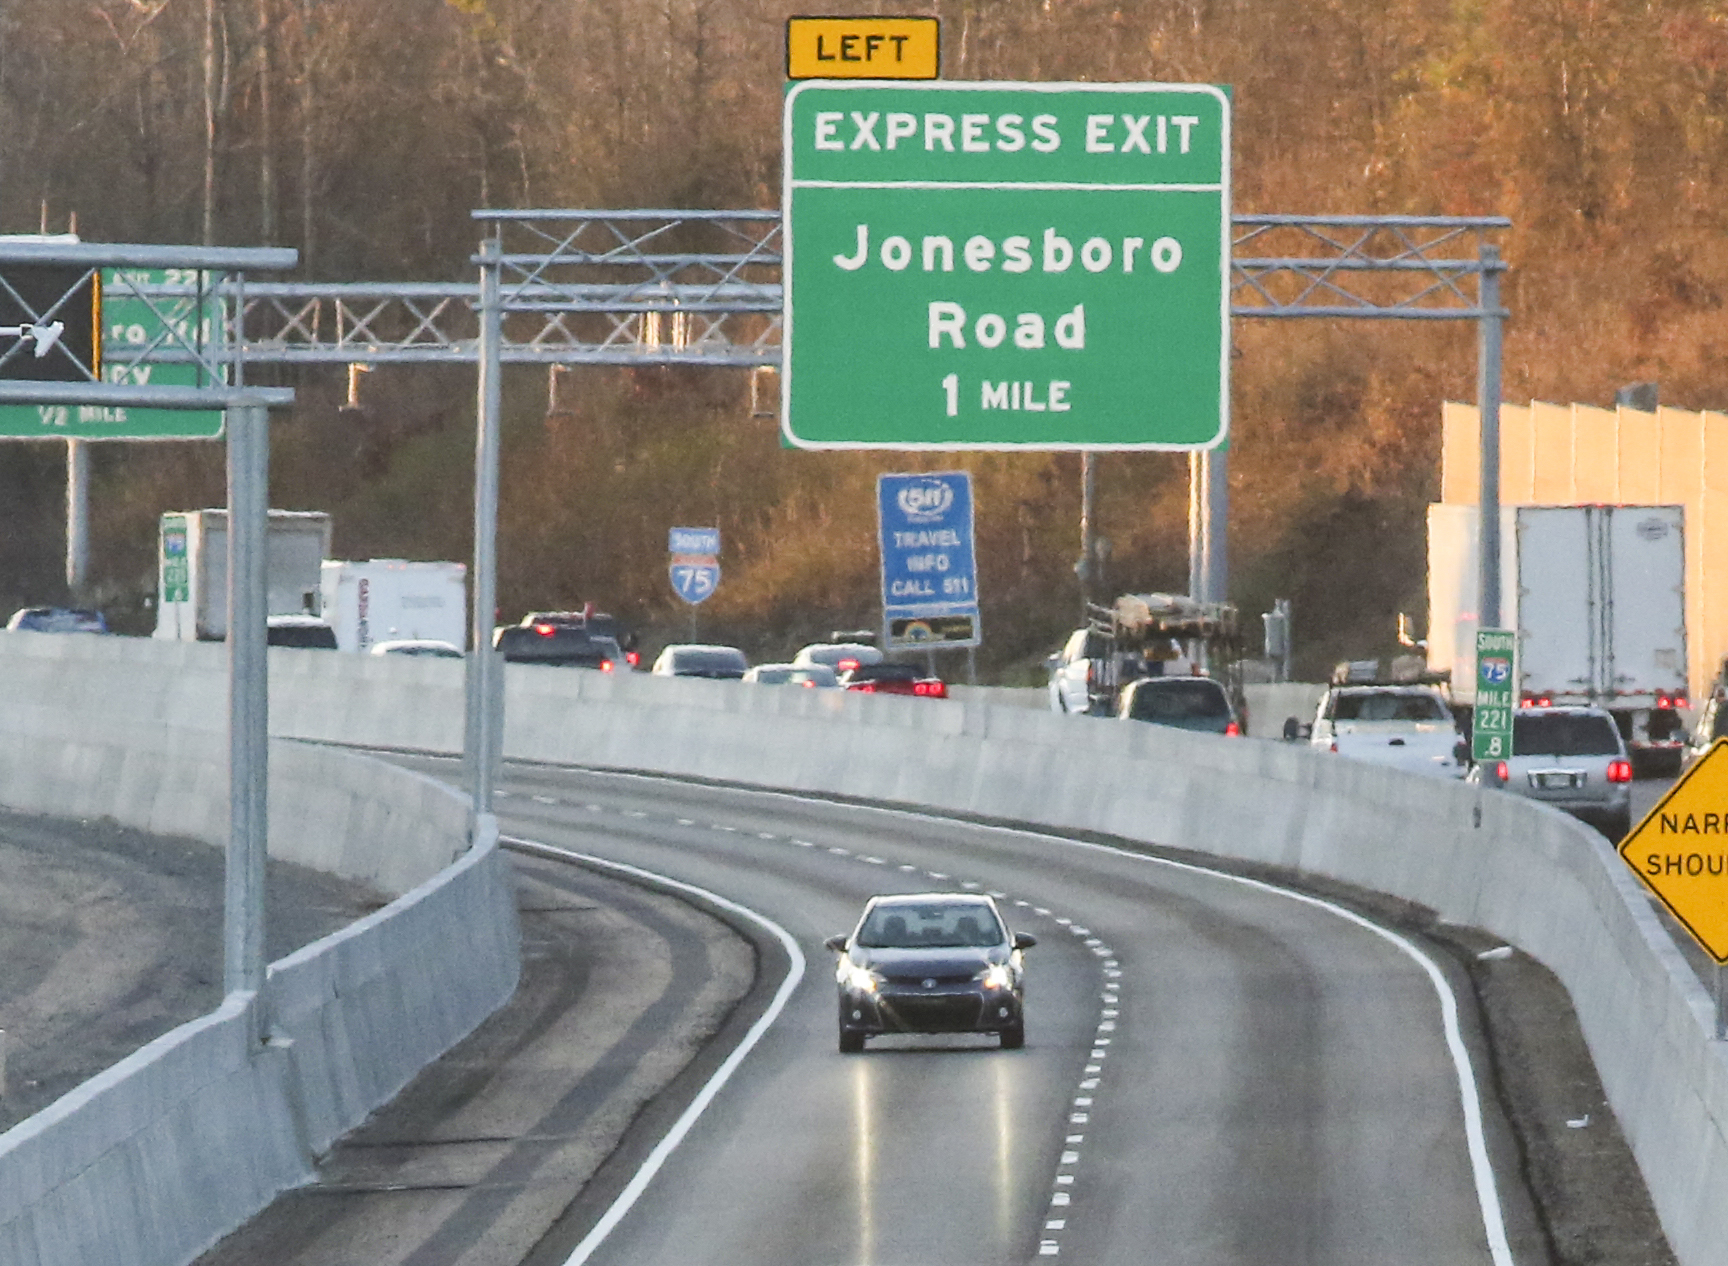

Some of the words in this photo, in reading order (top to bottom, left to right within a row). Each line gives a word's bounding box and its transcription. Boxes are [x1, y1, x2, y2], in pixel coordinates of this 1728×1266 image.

[816, 35, 909, 63] LEFT
[814, 111, 1062, 153] EXPRESS
[1084, 114, 1199, 154] EXIT
[832, 224, 1184, 274] Jonesboro
[928, 301, 1086, 350] Road
[942, 374, 958, 417] 1
[981, 381, 1071, 412] MILE
[79, 406, 128, 423] MILE
[893, 529, 961, 548] TRAVEL
[906, 554, 950, 572] INFO
[677, 568, 712, 594] 75
[890, 580, 935, 596] CALL
[943, 577, 970, 595] 511
[1477, 633, 1513, 652] SOUTH
[1483, 662, 1508, 680] 75
[1477, 691, 1511, 707] MILE
[1480, 710, 1507, 730] 221
[1484, 736, 1502, 757] .8
